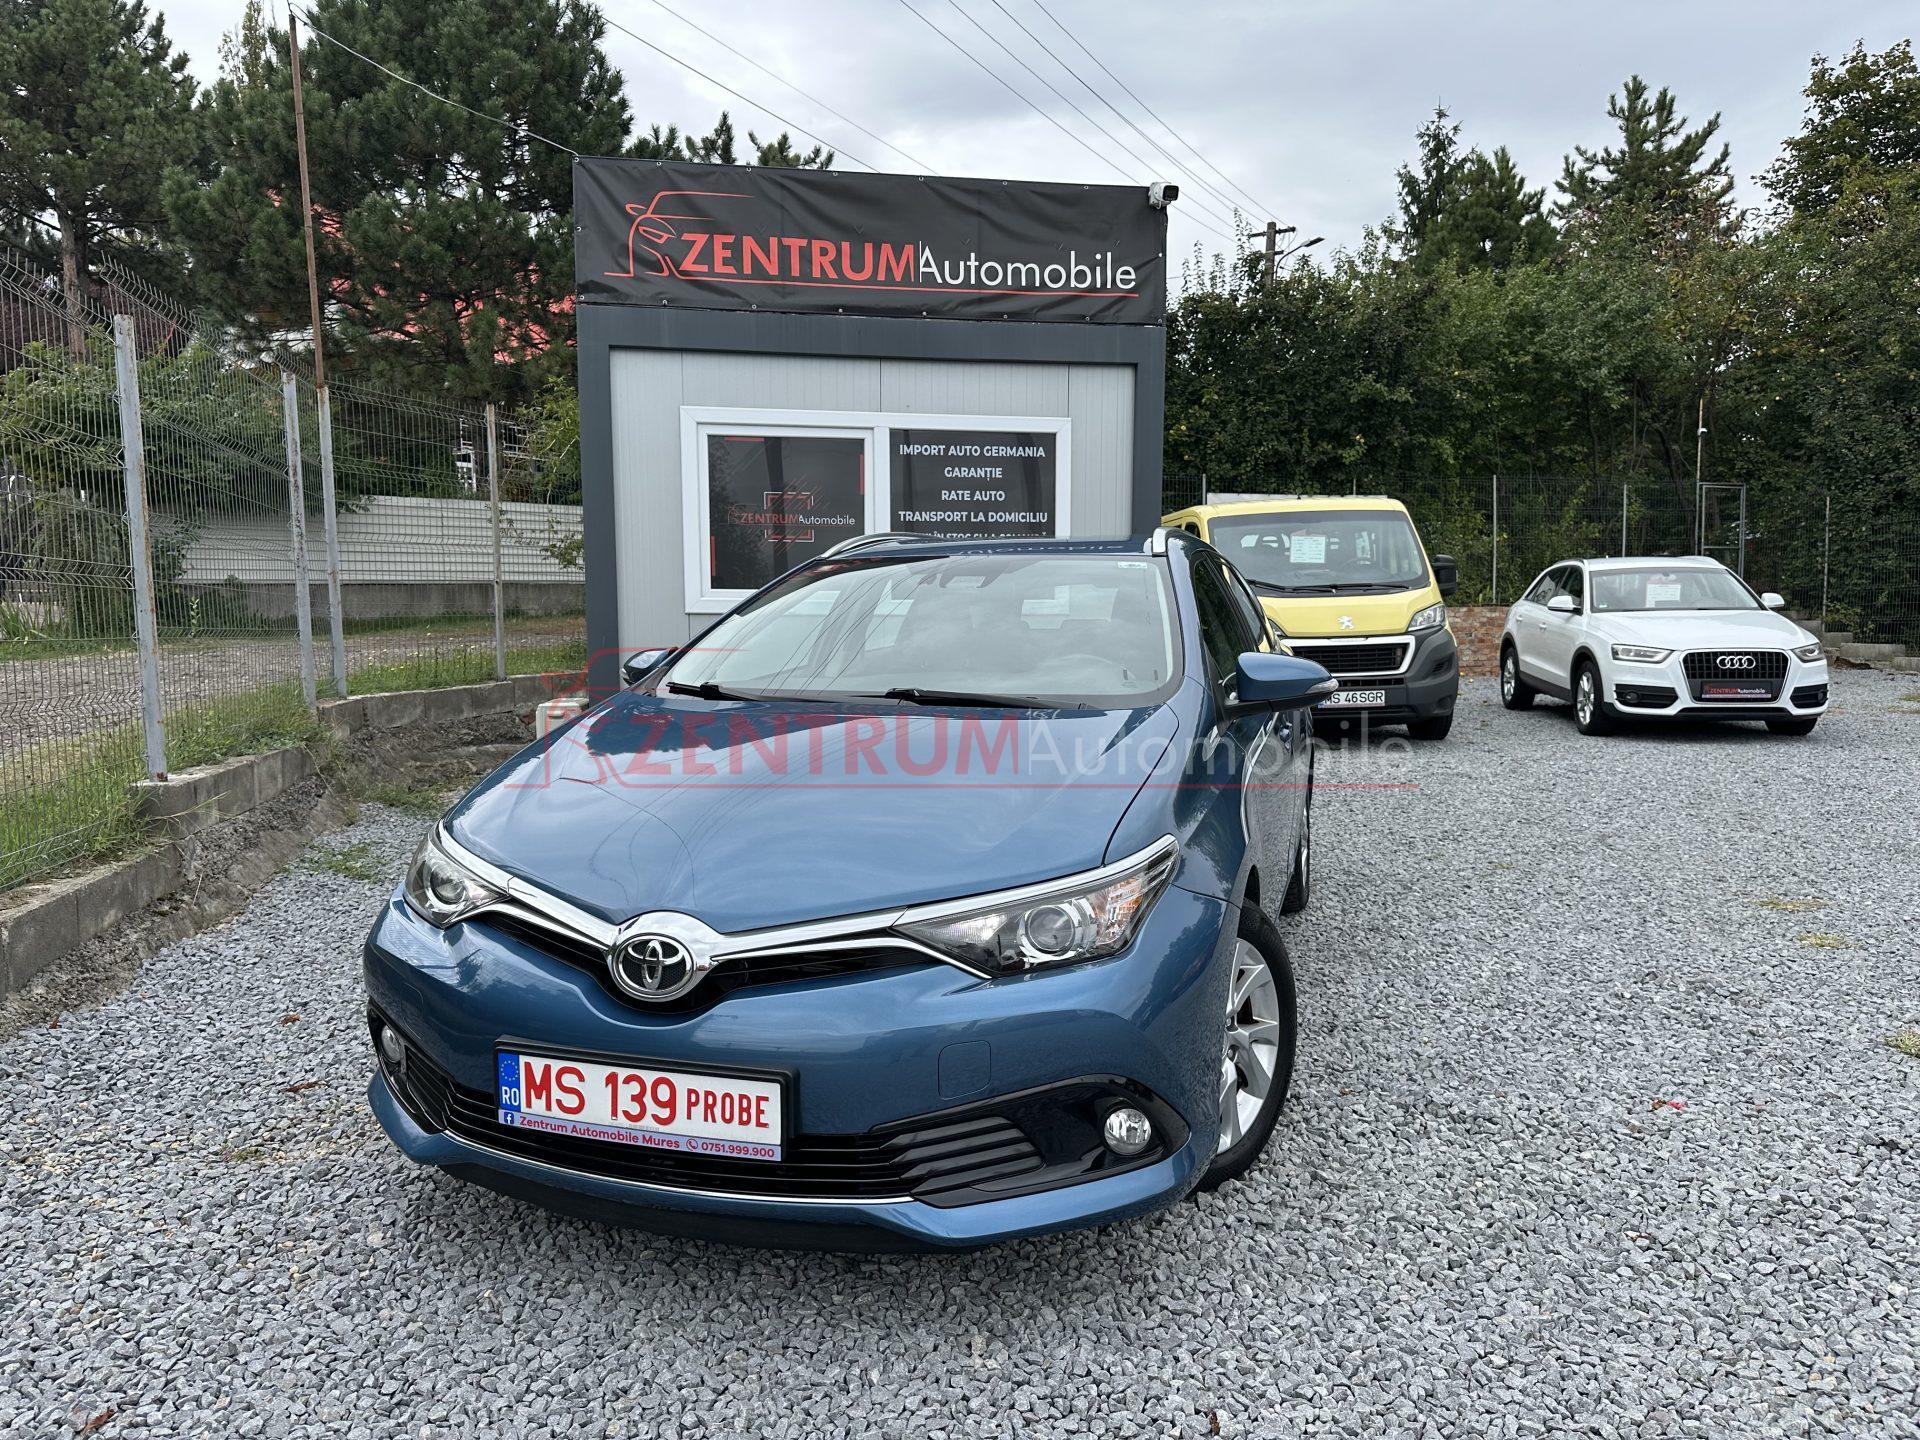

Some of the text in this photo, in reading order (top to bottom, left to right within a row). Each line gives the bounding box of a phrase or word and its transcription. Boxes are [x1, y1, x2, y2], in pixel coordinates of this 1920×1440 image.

[679, 233, 1137, 290] ZENTRUM Automobile
[899, 444, 1046, 458] IMPORT AUTO GERMANIA
[944, 467, 1003, 481] GARANȚIE
[941, 490, 1006, 501] RATE AUTO
[740, 513, 856, 526] ZENTRUM Automobile
[898, 511, 1048, 523] TRANSPORT LA DOMICILIU
[501, 1086, 520, 1106] RO
[524, 1061, 770, 1129] MS 139 PROBE
[519, 1115, 568, 1133] Zentrum
[570, 1124, 640, 1144] Automobile
[642, 1134, 681, 1149] Mures
[701, 1141, 775, 1158] 0751.999.900
